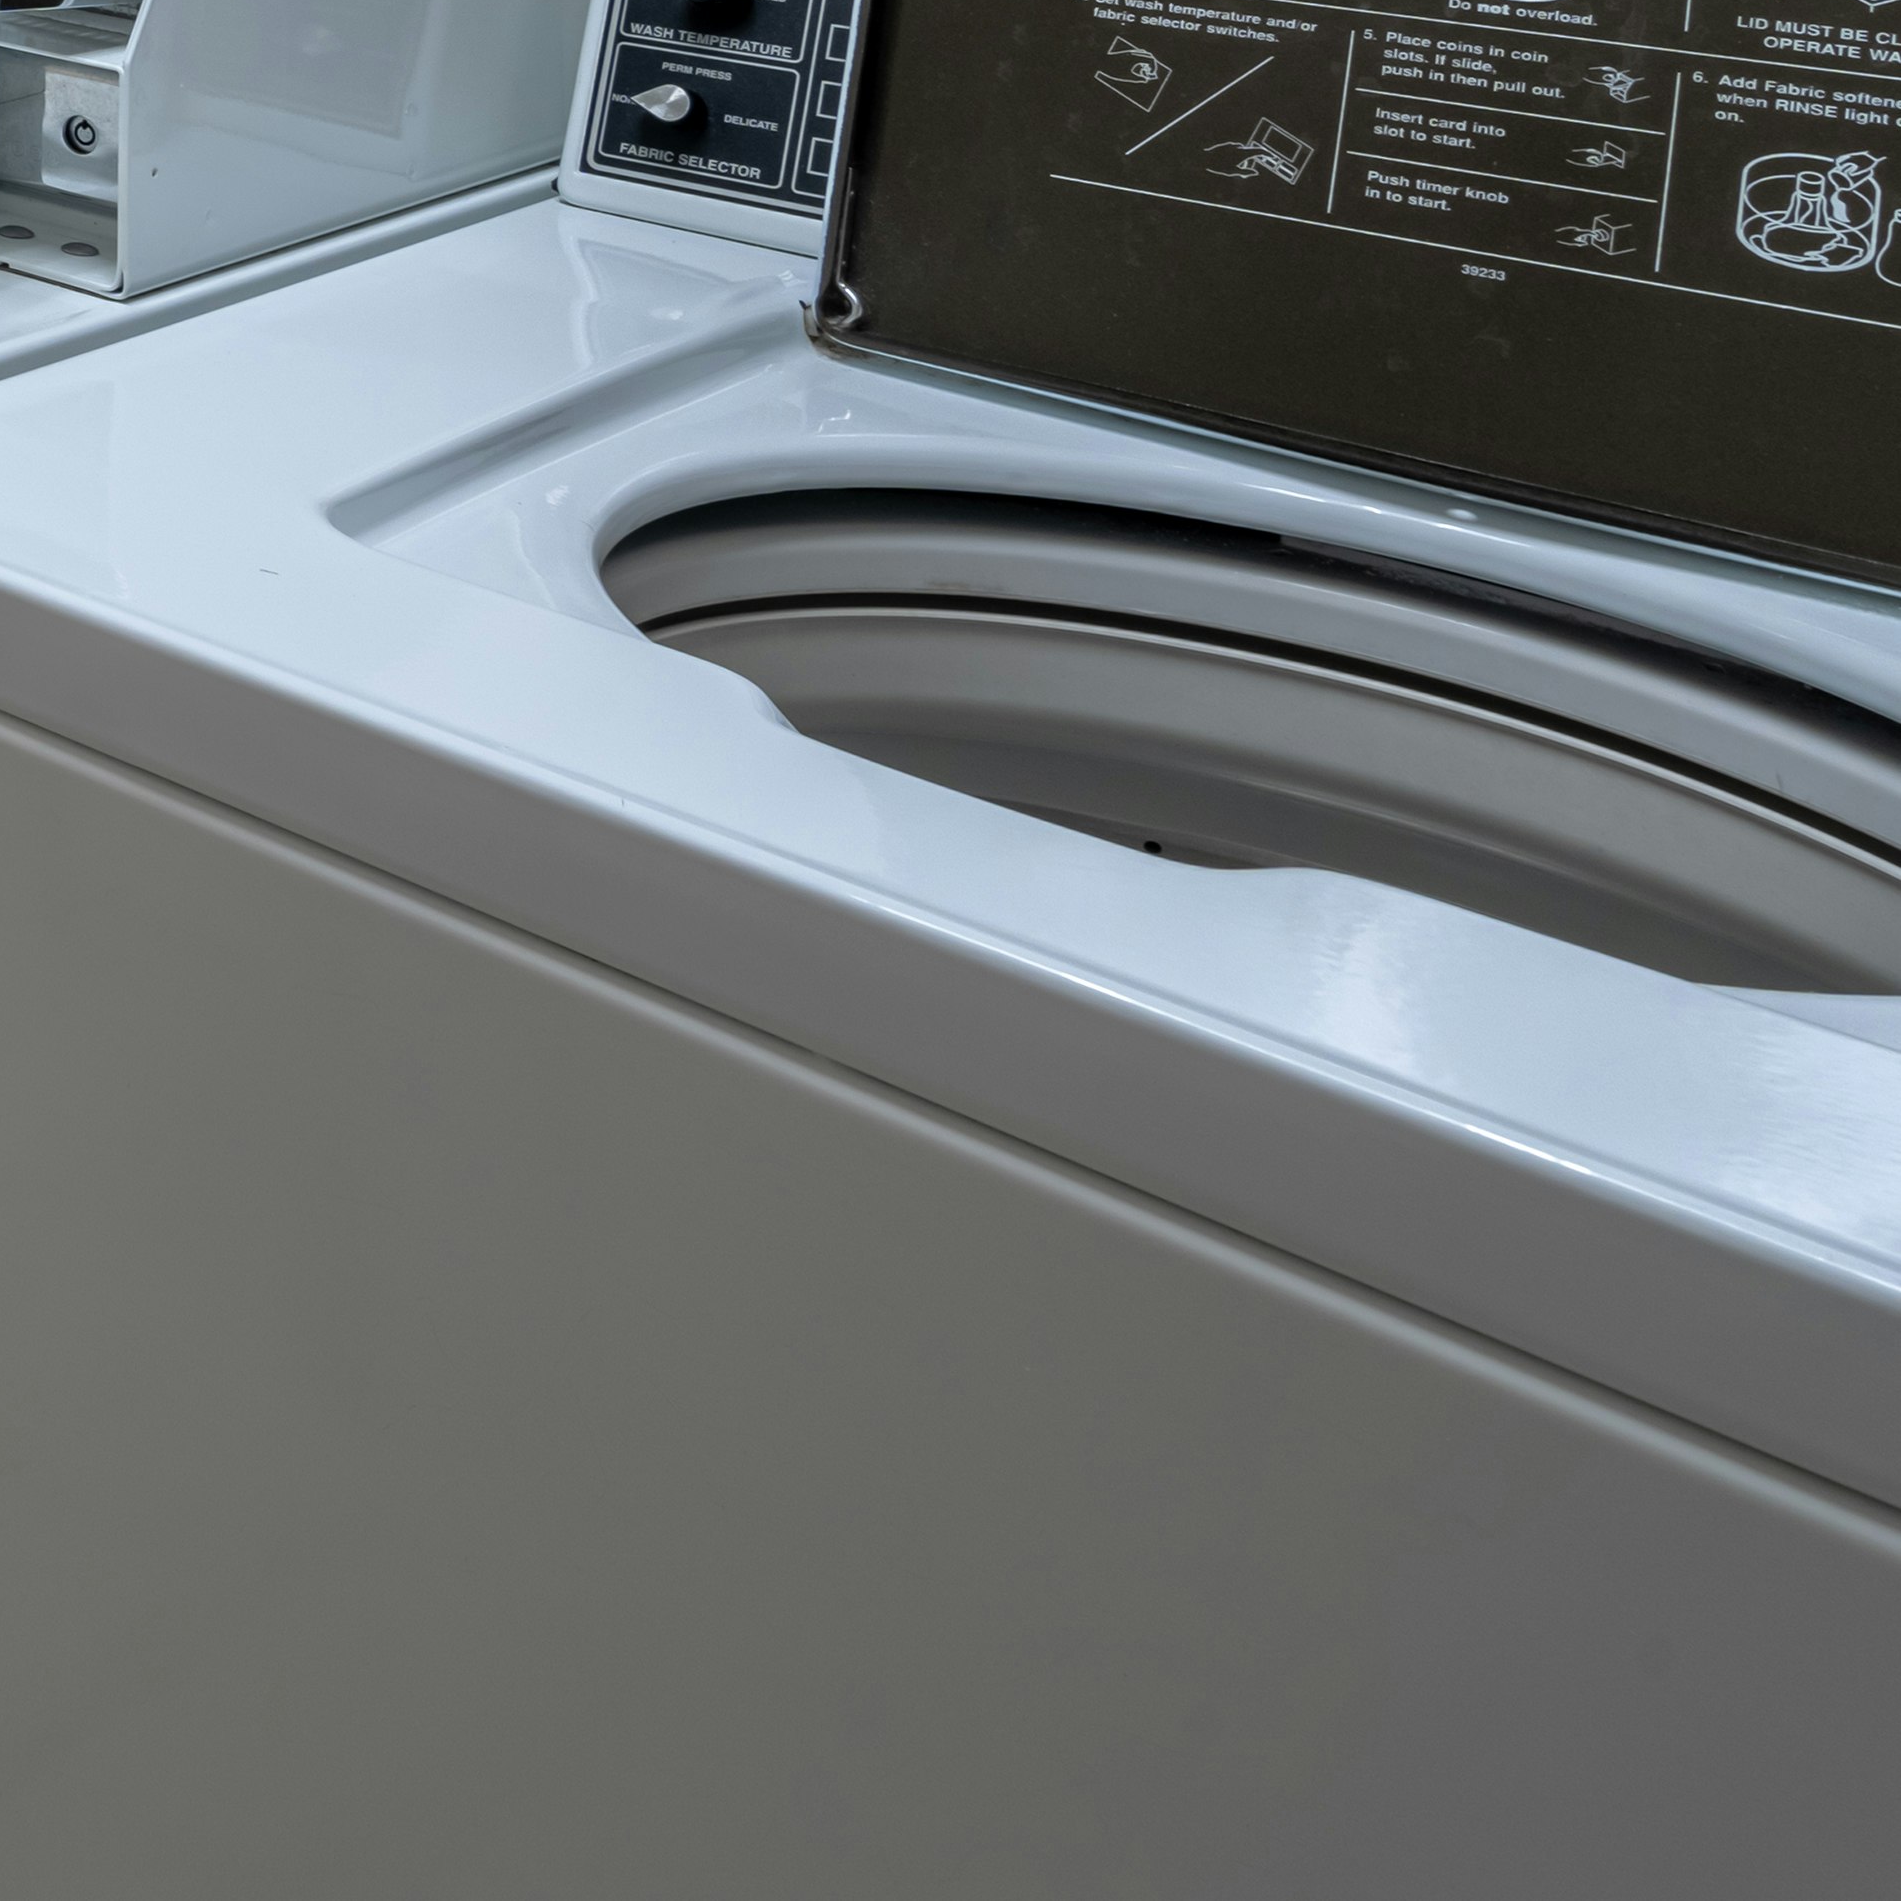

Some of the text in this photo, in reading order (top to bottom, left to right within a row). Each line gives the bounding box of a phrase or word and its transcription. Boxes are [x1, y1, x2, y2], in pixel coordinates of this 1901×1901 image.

[1168, 3, 1262, 24] temperature
[1266, 18, 1318, 32] and/or
[1477, 3, 1511, 16] not
[1516, 8, 1597, 26] overload.
[630, 22, 792, 58] WASH TEMPERATURE
[1737, 16, 1769, 30] LID
[1775, 20, 1834, 37] MUST
[1840, 28, 1869, 42] BE
[1363, 28, 1549, 63] 5. Place coins in coin
[1763, 36, 1861, 59] OPERATE
[662, 61, 732, 81] PERM PRESS
[1384, 48, 1497, 74] slots. If slide,
[1381, 65, 1565, 98] push in then pull out.
[1692, 71, 1708, 83] 6.
[1718, 74, 1758, 90] Add
[1764, 80, 1826, 99] Fabric
[724, 114, 779, 132] DELICATE
[1375, 107, 1506, 137] Insert card into
[1714, 110, 1744, 123] on.
[1716, 93, 1889, 125] when RINSE light
[619, 142, 761, 180] FABRIC SELECTOR
[1367, 170, 1509, 204] Push timer knob
[1461, 264, 1506, 281] 39233
